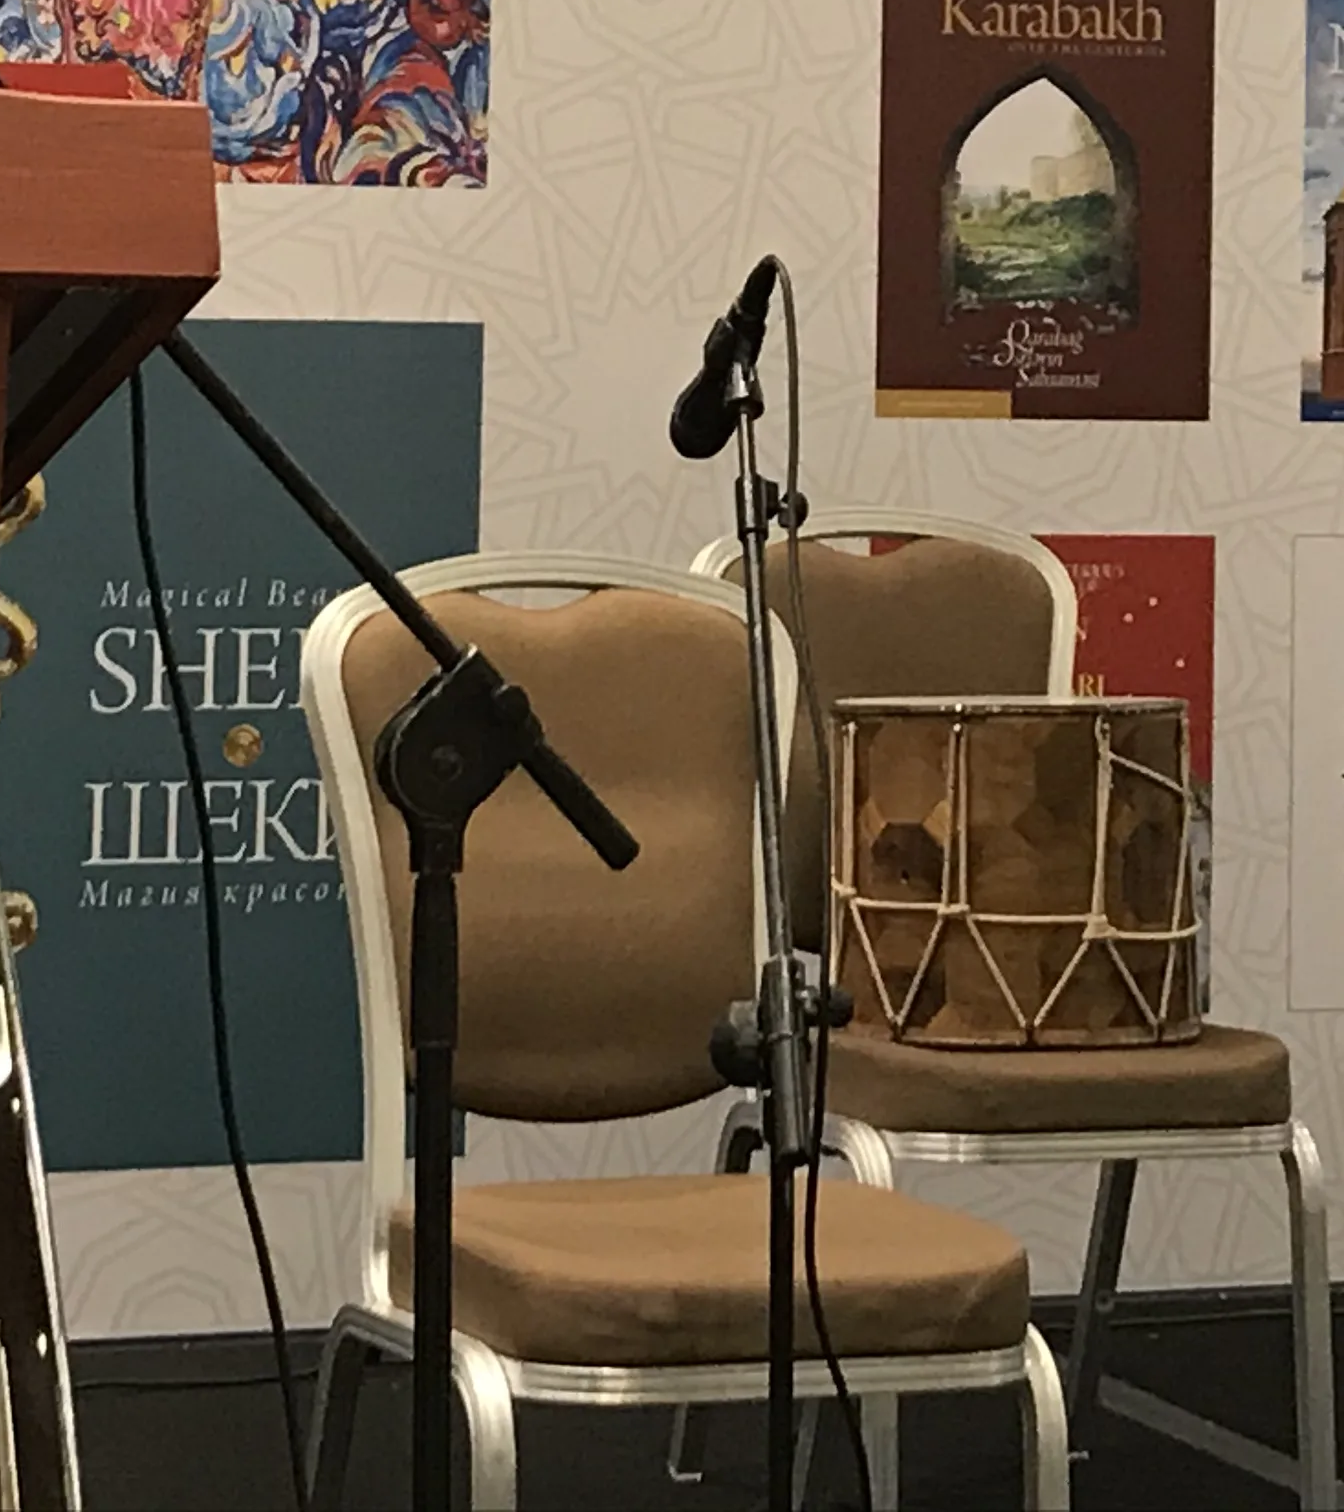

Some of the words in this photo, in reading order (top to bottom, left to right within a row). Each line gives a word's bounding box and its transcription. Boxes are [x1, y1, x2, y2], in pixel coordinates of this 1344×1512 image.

[100, 577, 248, 616] Magical
[268, 579, 346, 606] Bea
[78, 879, 201, 909] Магия
